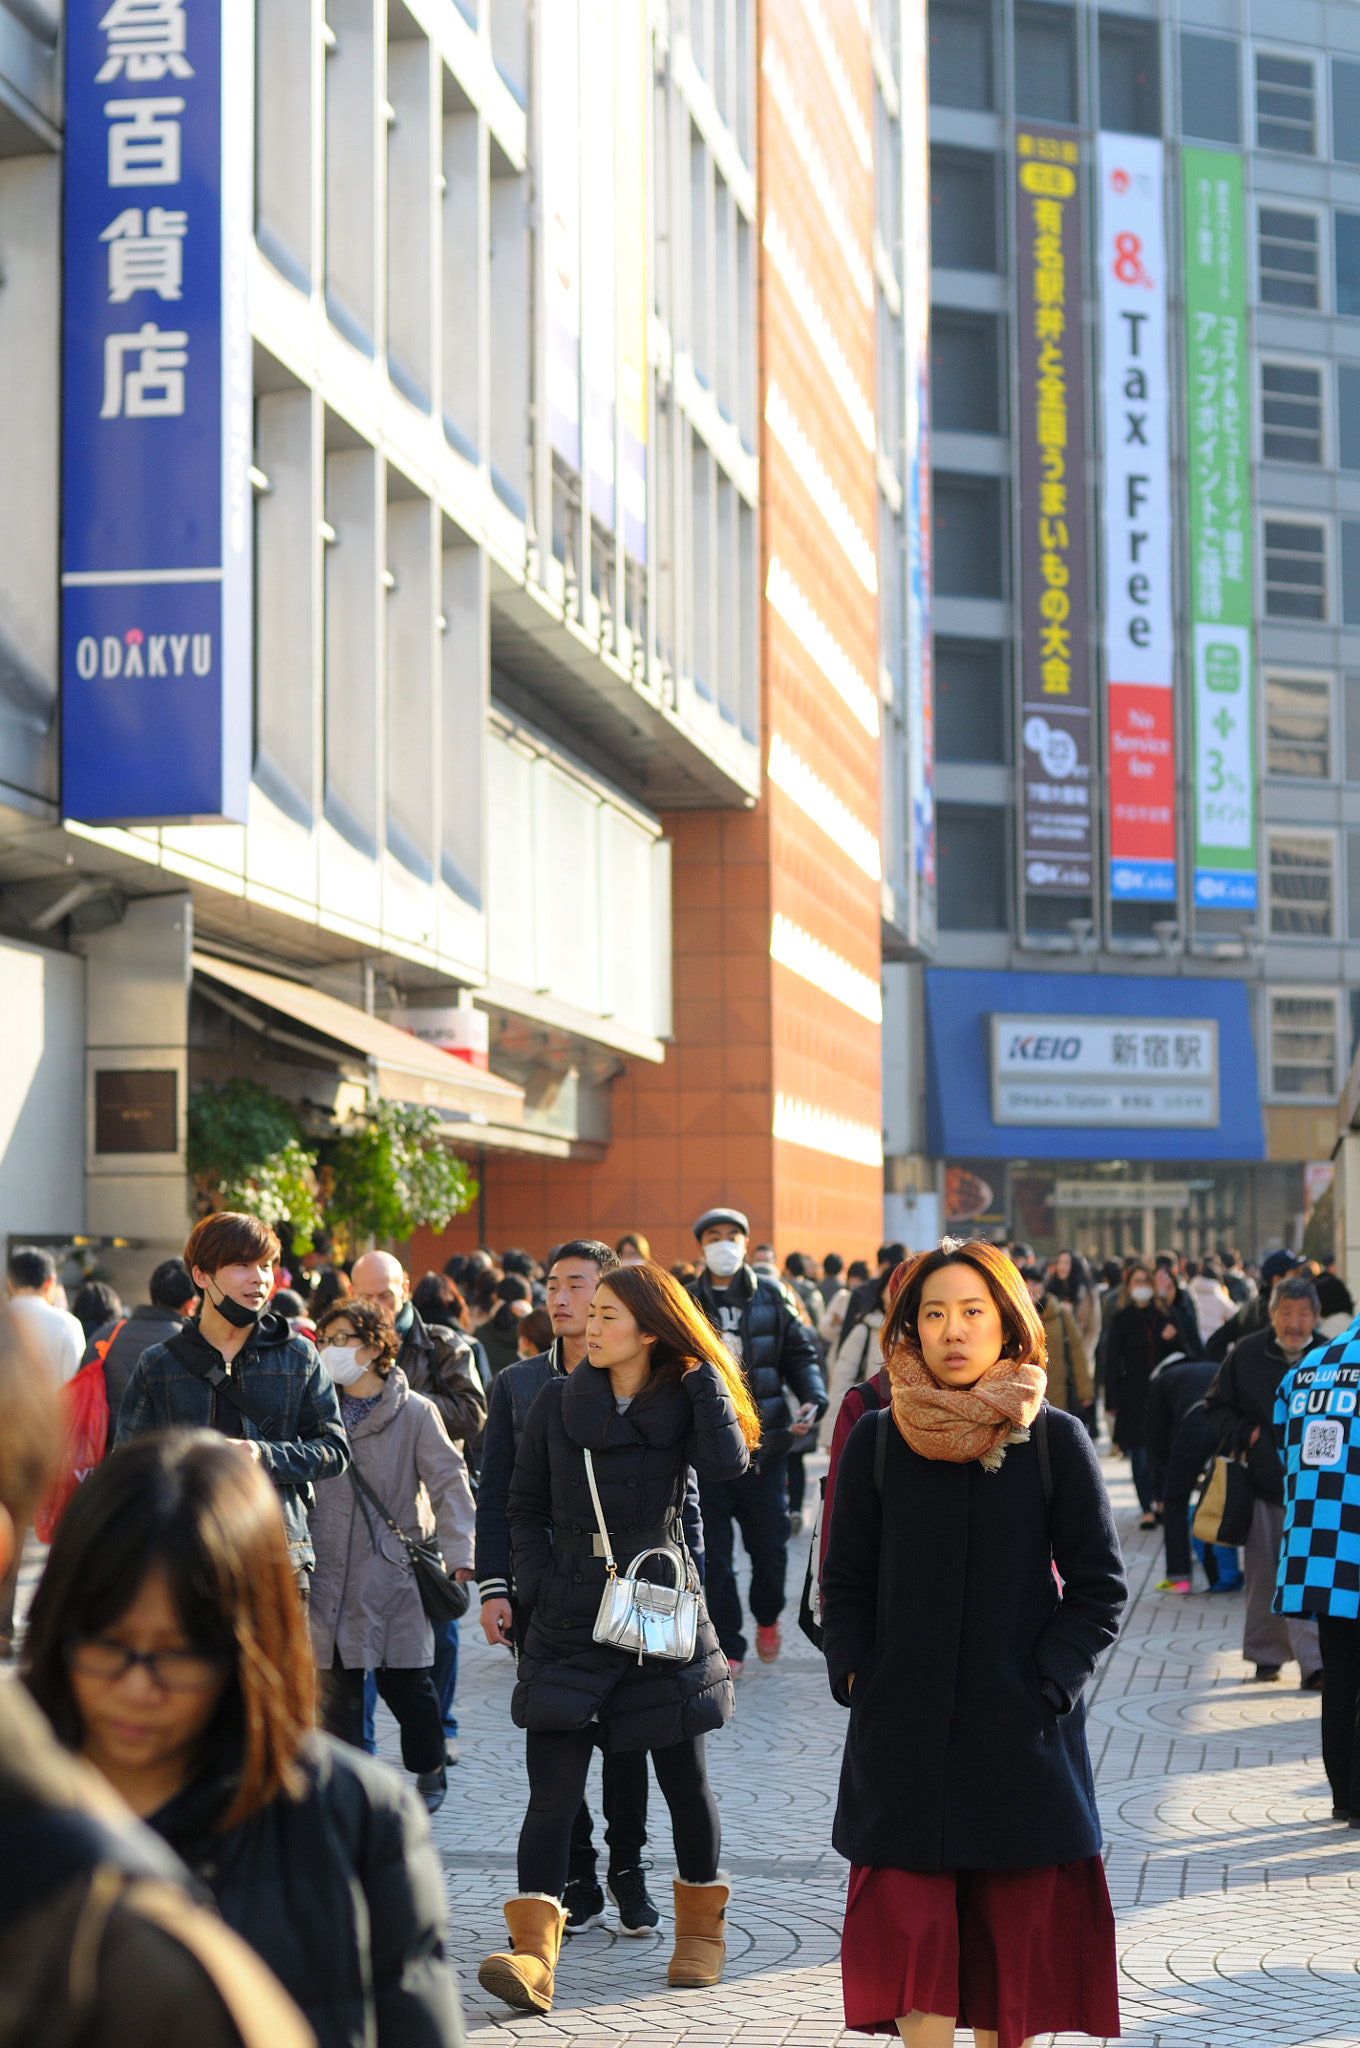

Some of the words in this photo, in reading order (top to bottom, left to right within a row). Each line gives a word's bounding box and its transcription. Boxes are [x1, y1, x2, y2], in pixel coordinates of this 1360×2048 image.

[1119, 309, 1149, 447] Tax
[1126, 474, 1152, 649] Free
[75, 627, 212, 681] ODAKYU
[1009, 1036, 1083, 1061] KEIO
[1112, 1034, 1202, 1069] 新宿駅
[1292, 1391, 1360, 1415] GUID
